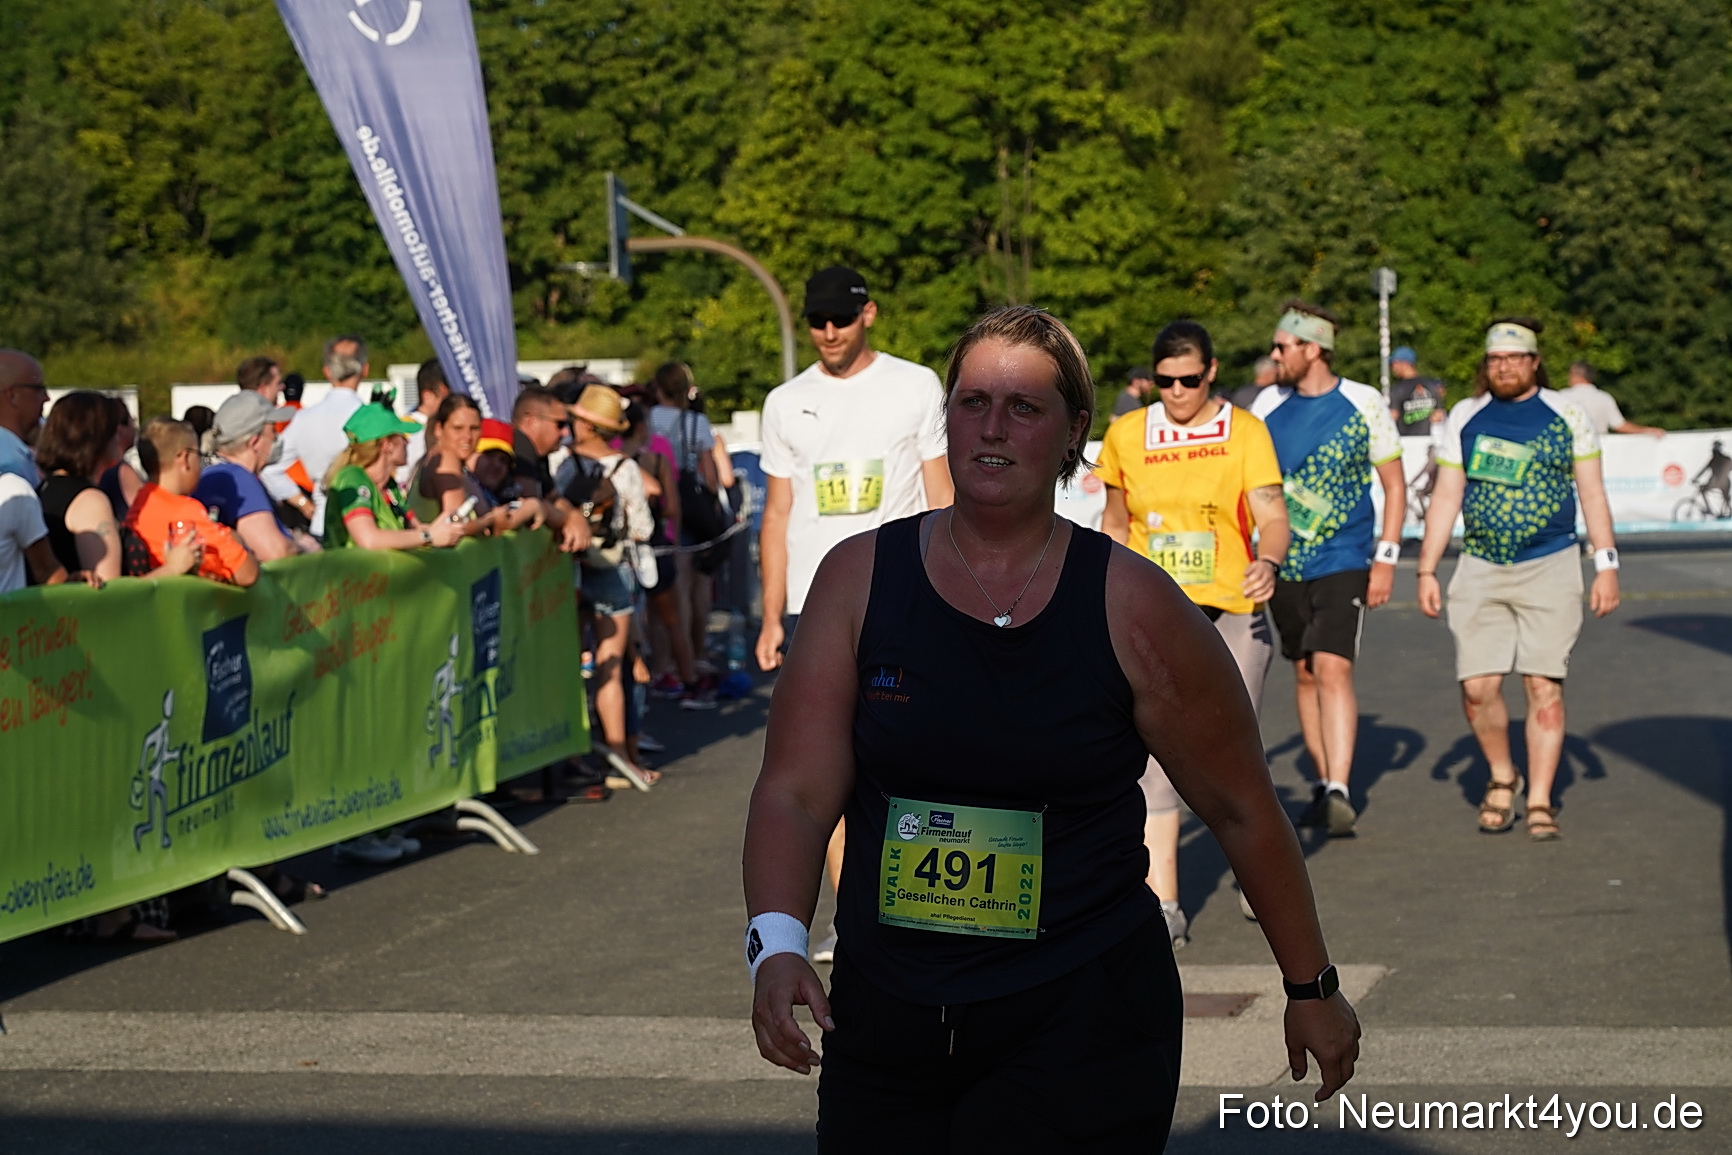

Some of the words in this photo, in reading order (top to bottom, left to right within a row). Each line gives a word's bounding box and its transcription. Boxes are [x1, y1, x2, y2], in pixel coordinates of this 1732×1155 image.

[1144, 452, 1180, 464] MAX
[1188, 446, 1229, 459] BÖGL
[827, 477, 872, 495] 117
[1158, 550, 1203, 567] 1148
[872, 666, 903, 688] aha!
[894, 693, 910, 703] mir
[176, 690, 296, 810] firmenlauf
[920, 826, 973, 838] Firmenlauf
[885, 847, 902, 907] WALK
[914, 847, 997, 894] 491
[897, 888, 965, 907] Gesellchen
[969, 897, 1016, 911] Cathrin
[1017, 863, 1034, 920] 2022
[942, 913, 976, 922] Pflegedienst
